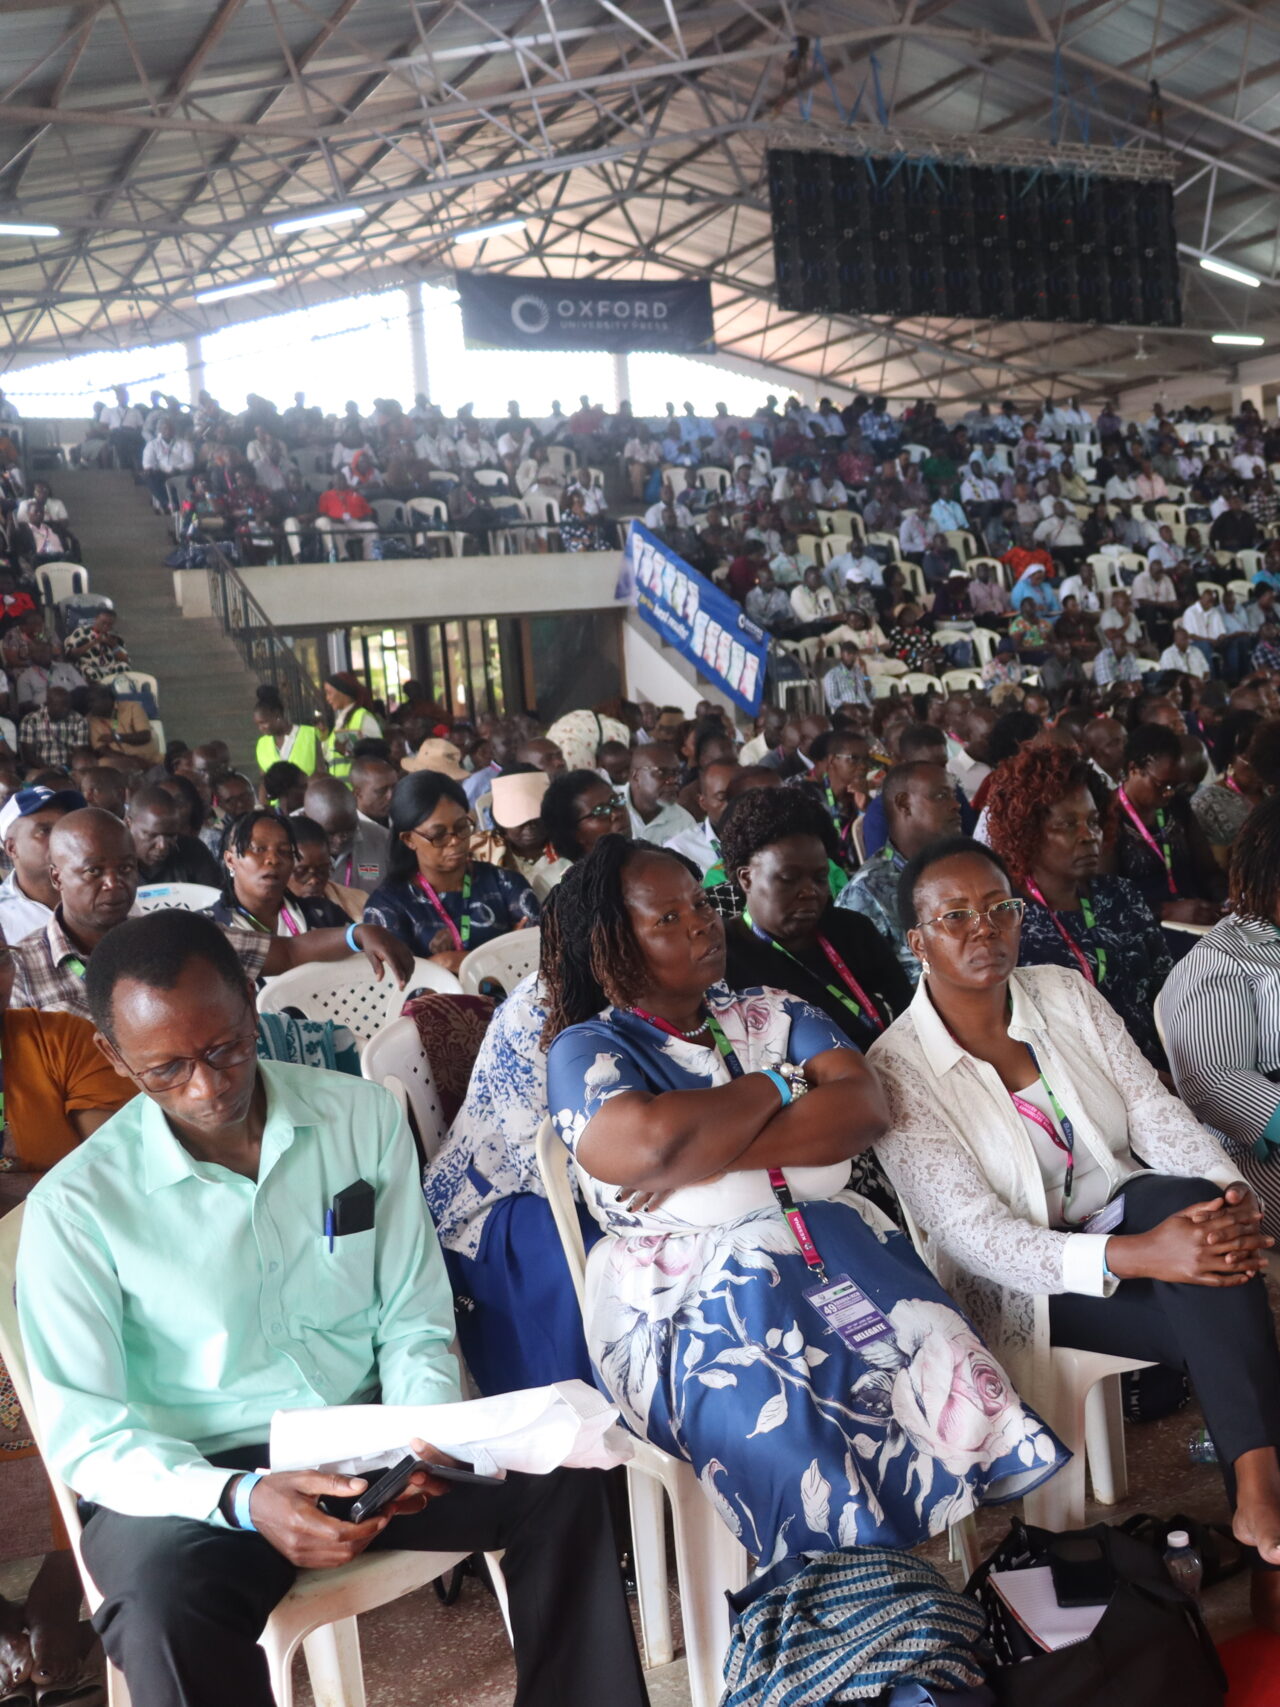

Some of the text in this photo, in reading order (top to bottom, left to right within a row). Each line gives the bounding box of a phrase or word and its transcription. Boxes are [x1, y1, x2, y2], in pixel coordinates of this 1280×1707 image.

[557, 299, 668, 319] OXFORD
[560, 320, 629, 331] UNIVERSITY
[822, 1302, 837, 1316] 49
[853, 1322, 887, 1343] DELEGATE
